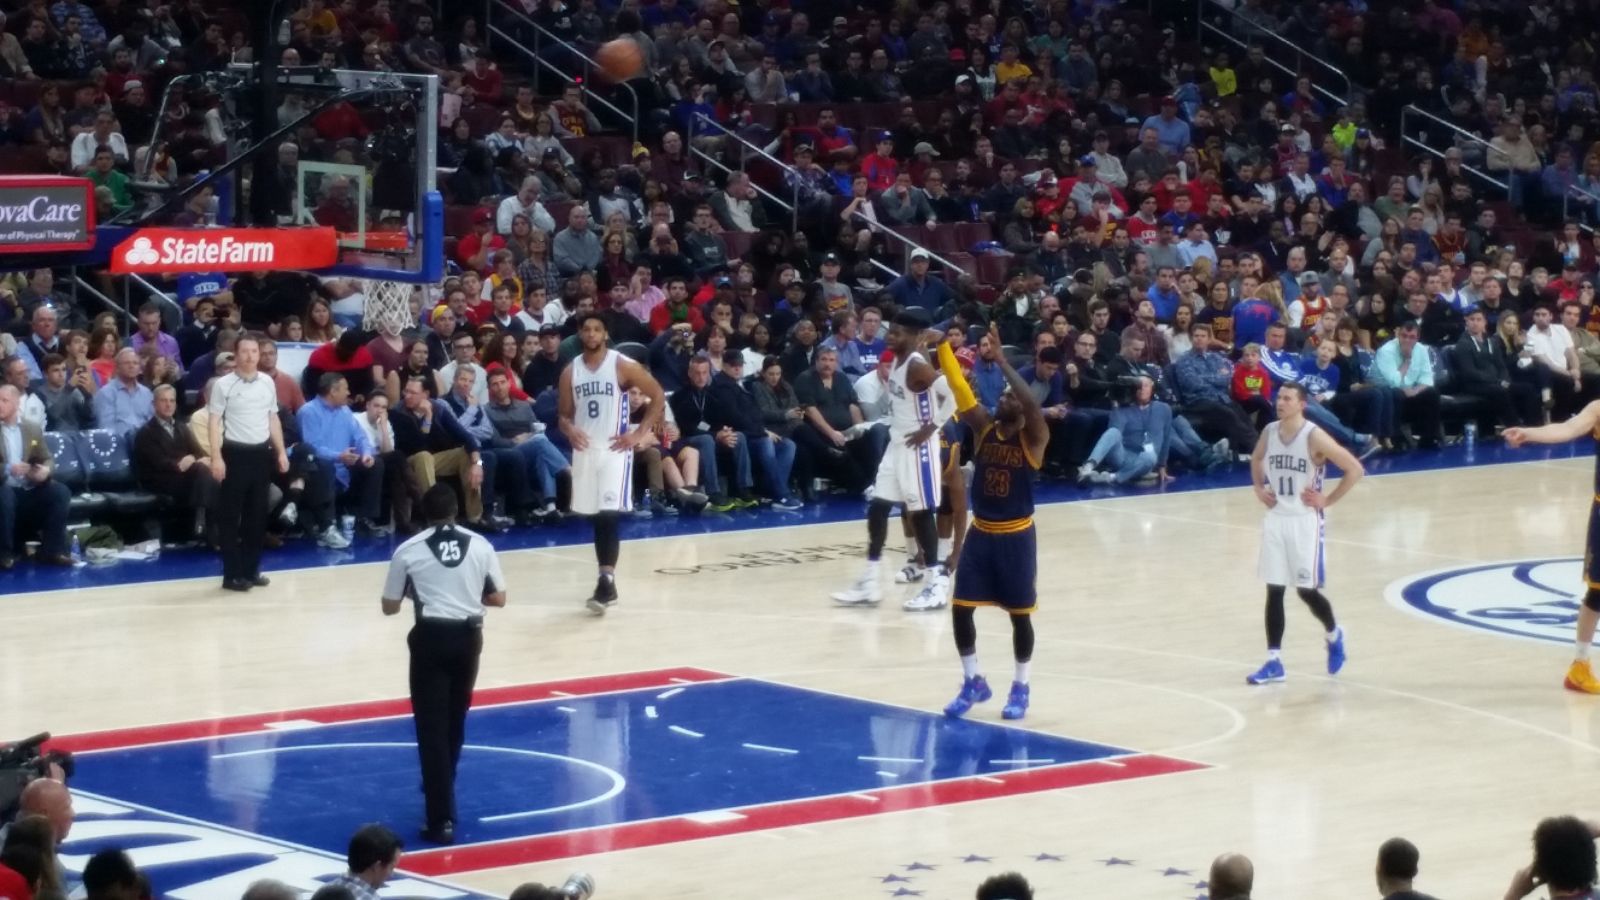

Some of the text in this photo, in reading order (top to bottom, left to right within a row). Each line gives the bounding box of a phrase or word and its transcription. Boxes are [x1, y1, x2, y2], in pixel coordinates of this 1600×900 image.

[575, 381, 614, 399] PHILA
[588, 400, 600, 419] 8
[1268, 454, 1307, 473] PHILA
[984, 467, 1010, 498] 23
[1278, 475, 1294, 496] 11
[439, 540, 461, 561] 25
